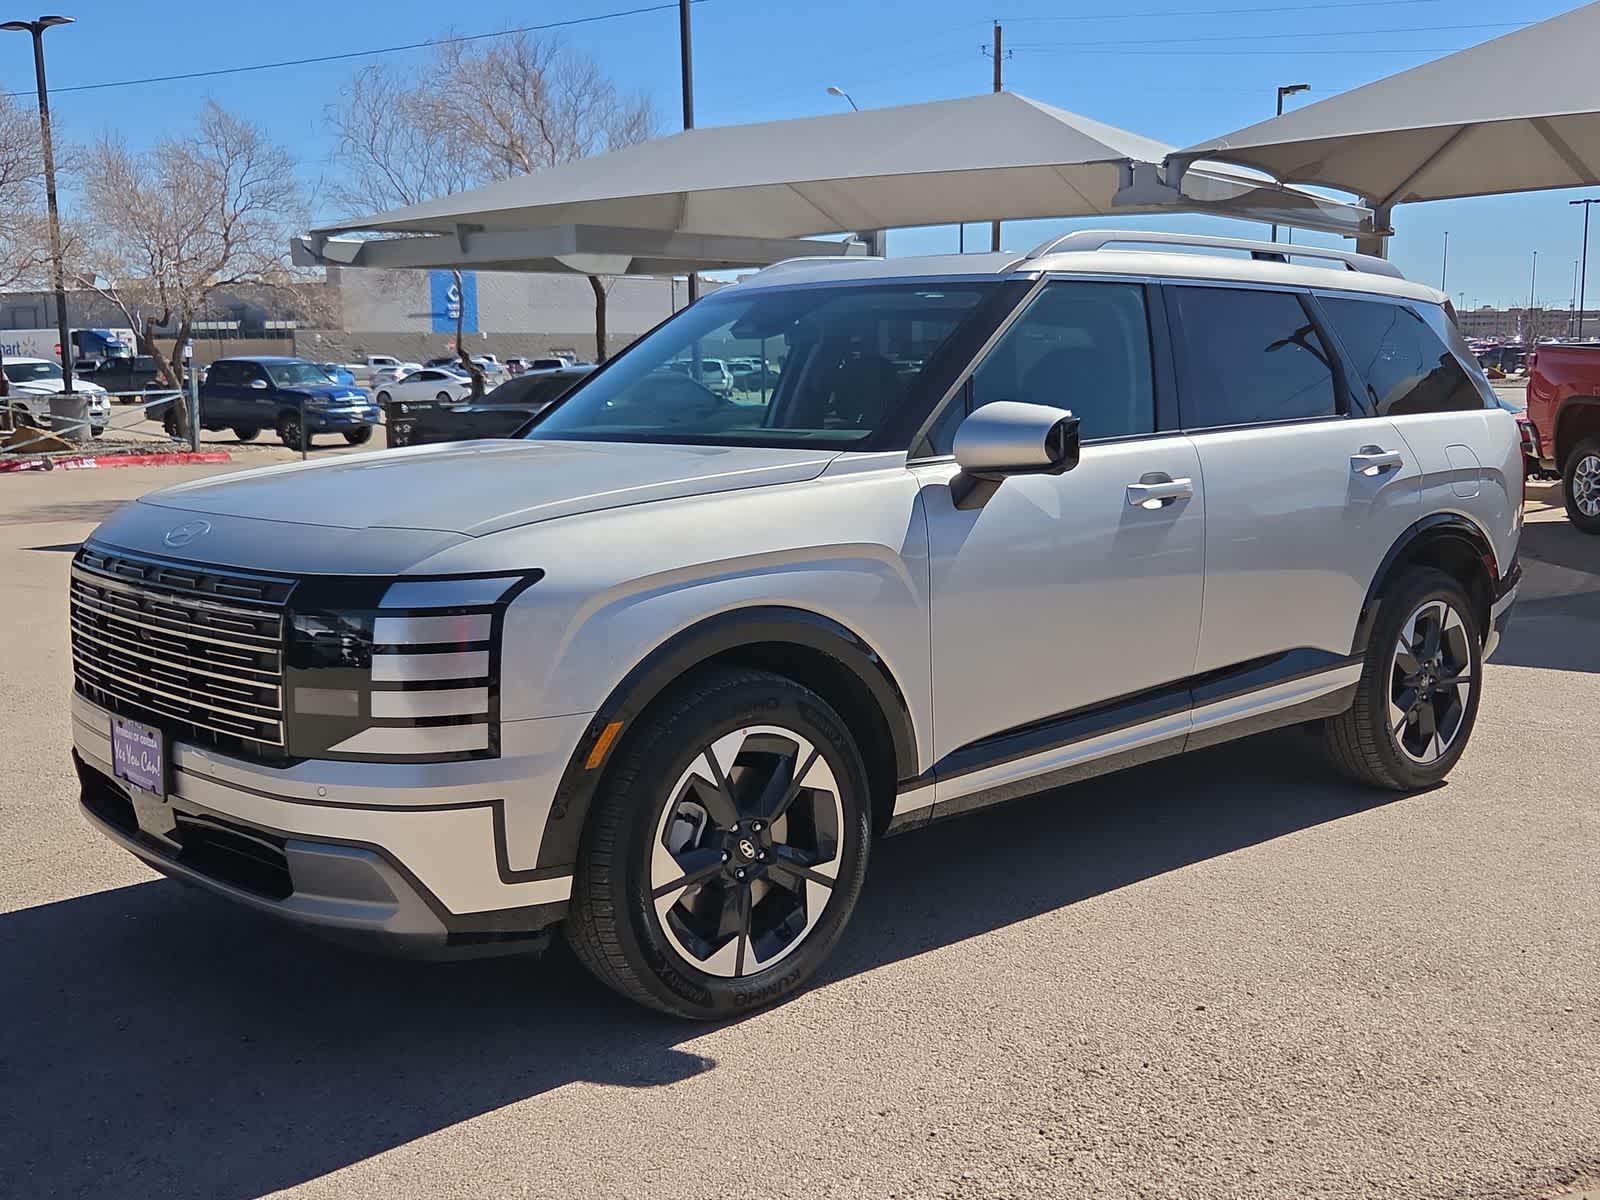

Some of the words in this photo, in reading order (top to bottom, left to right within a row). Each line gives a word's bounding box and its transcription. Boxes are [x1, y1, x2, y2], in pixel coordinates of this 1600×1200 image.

[114, 738, 126, 762] Yes
[126, 744, 140, 766] You
[141, 751, 161, 777] Can!
